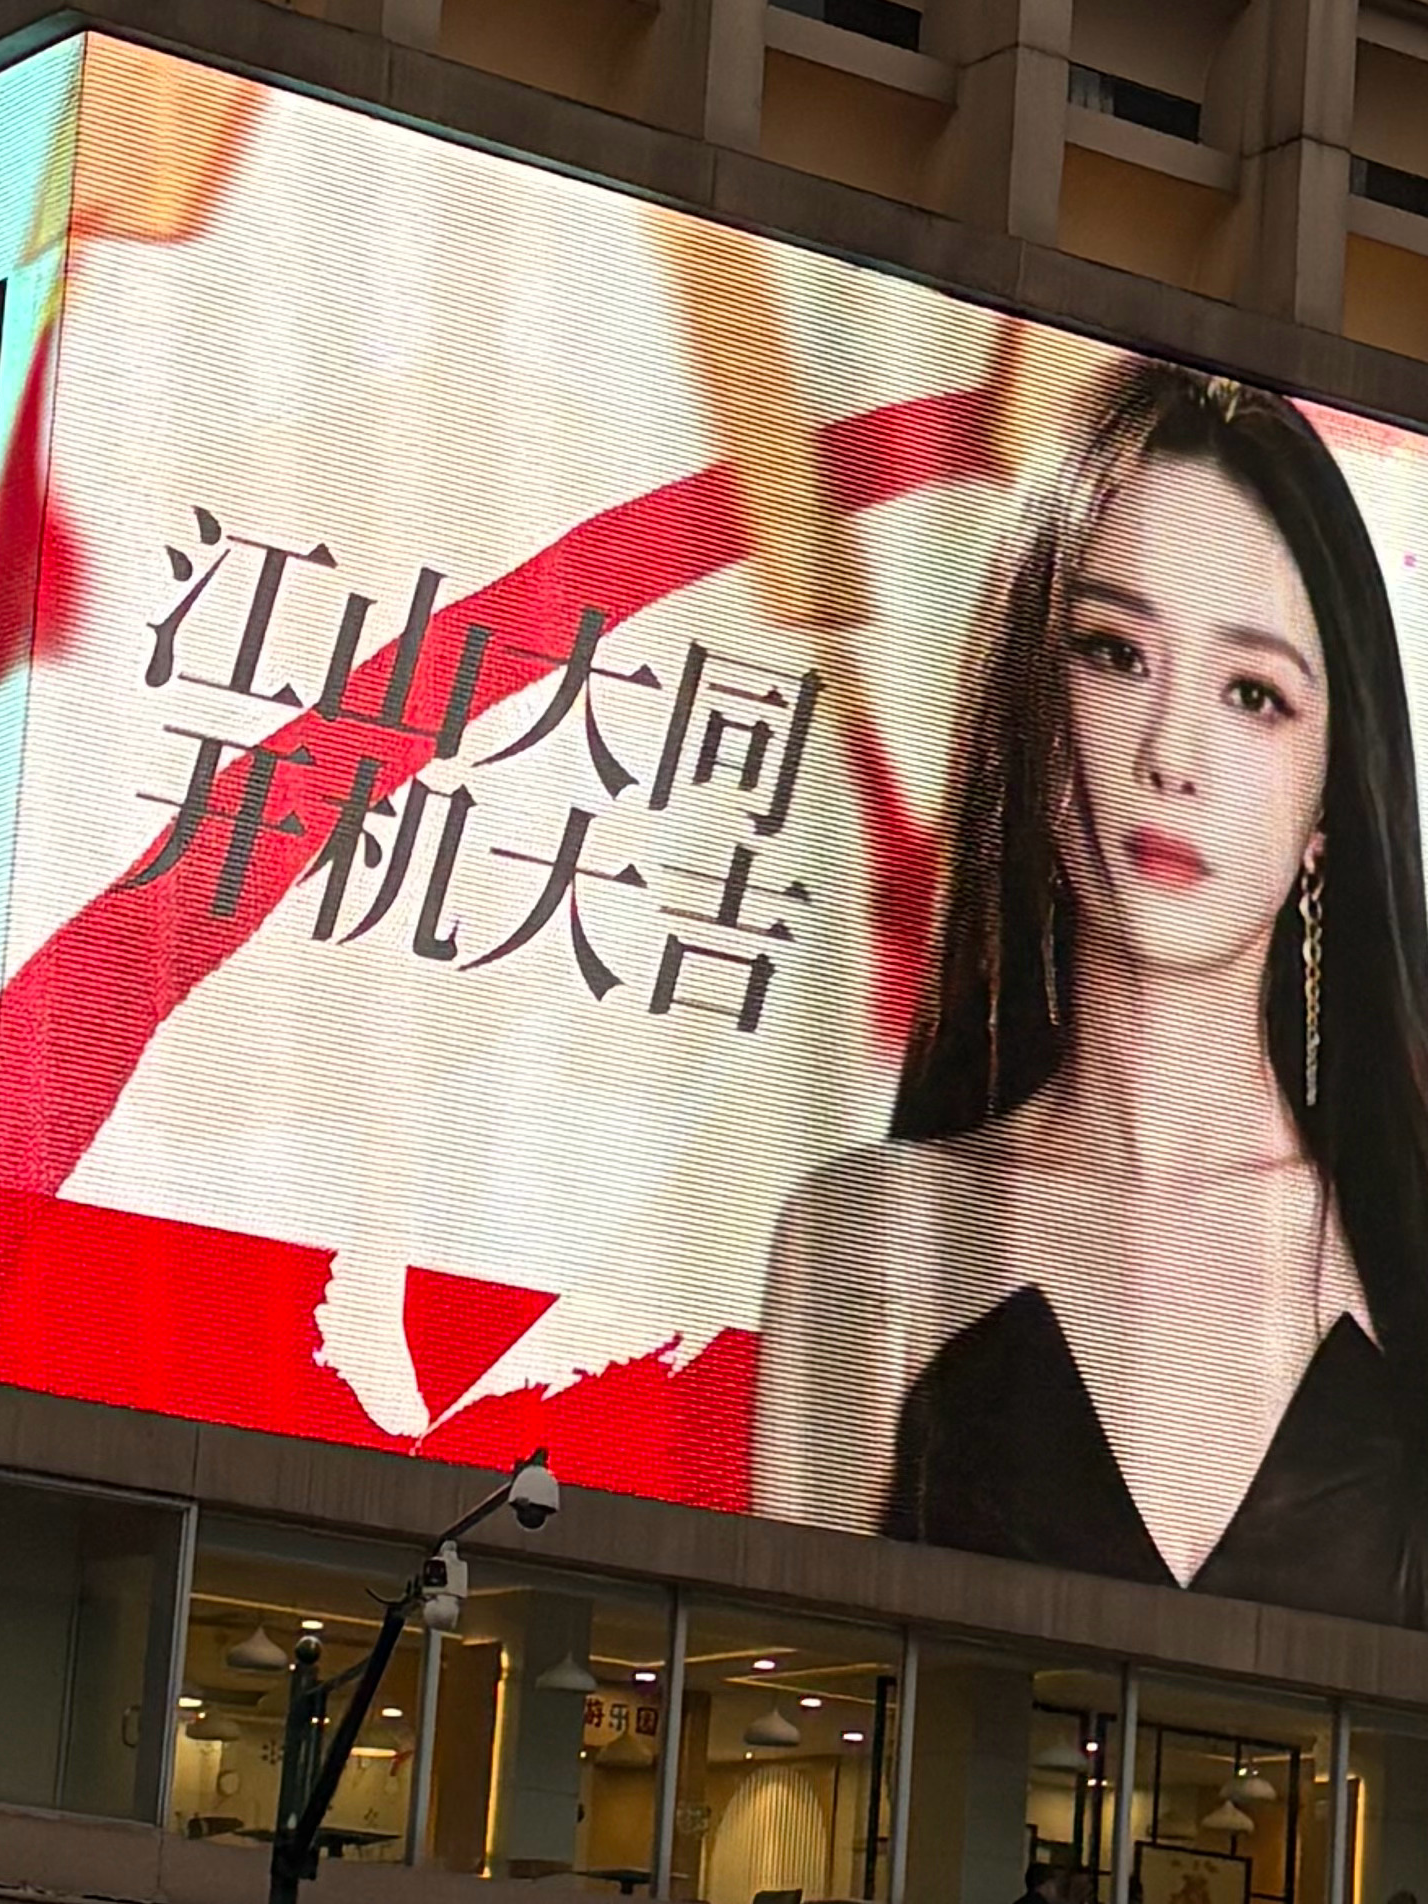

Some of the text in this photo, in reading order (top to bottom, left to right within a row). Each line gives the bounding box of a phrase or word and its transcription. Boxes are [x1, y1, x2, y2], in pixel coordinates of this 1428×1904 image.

[144, 504, 826, 836] 江山大同
[136, 724, 813, 1034] 开机大吉
